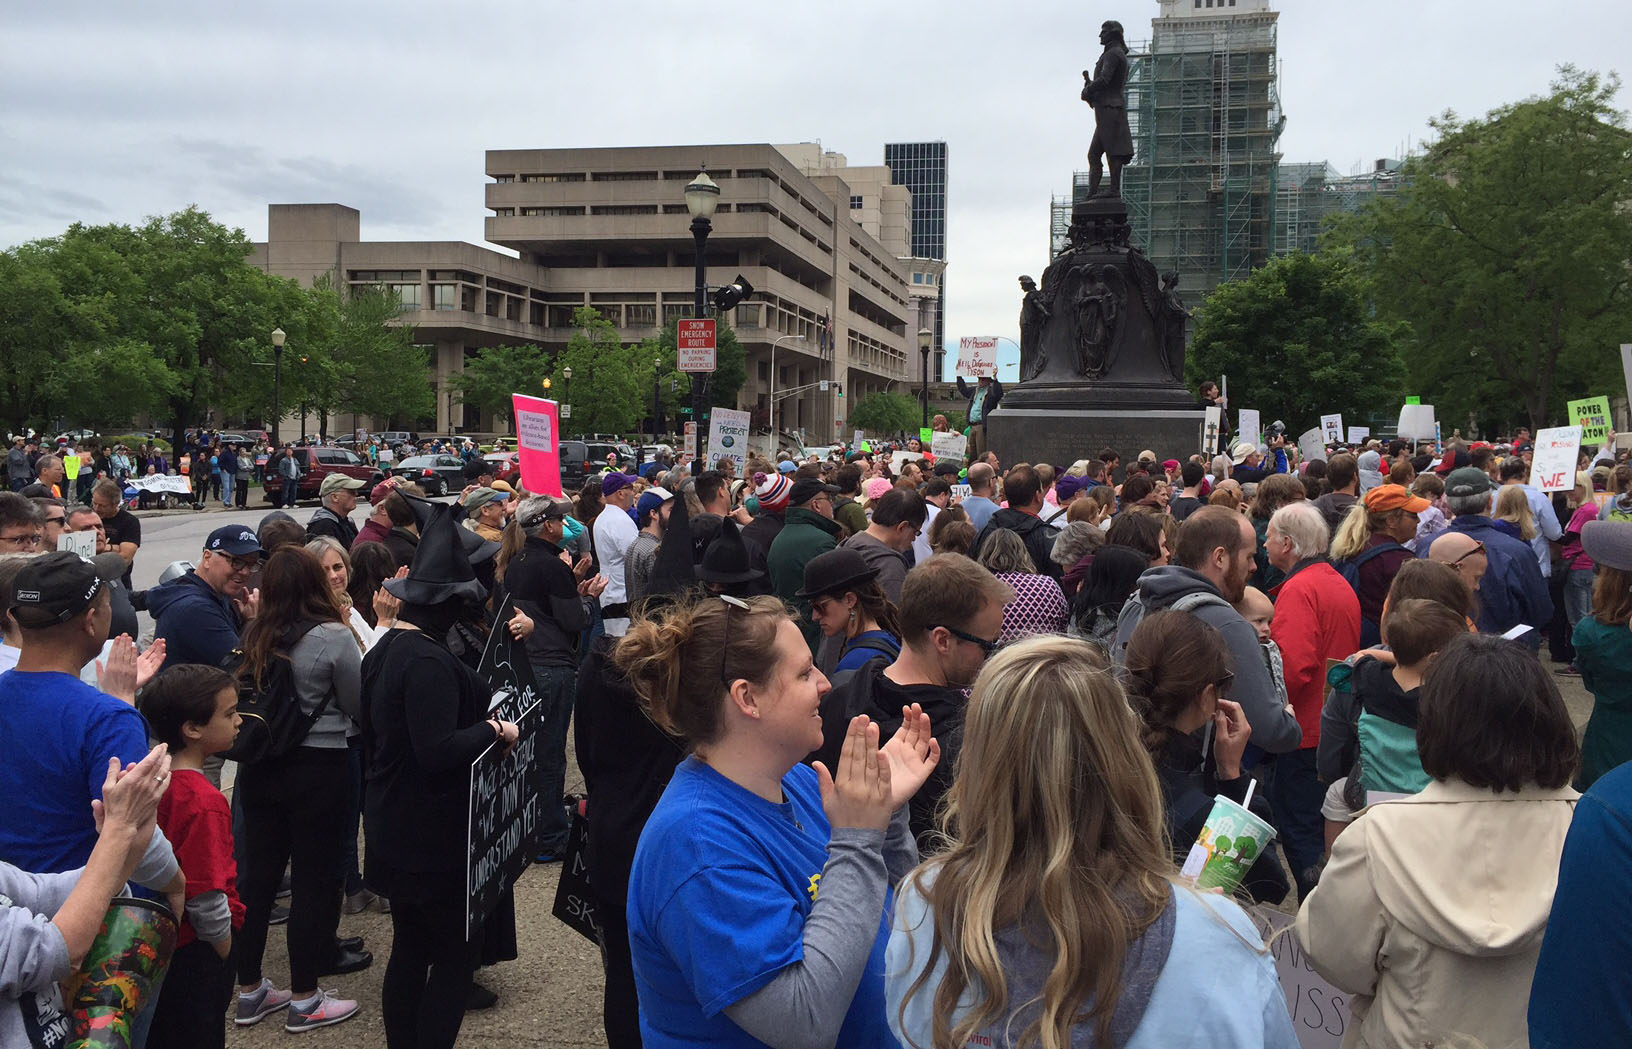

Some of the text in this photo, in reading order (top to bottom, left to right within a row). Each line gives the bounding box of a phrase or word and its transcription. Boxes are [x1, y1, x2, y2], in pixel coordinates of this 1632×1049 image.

[689, 321, 705, 330] SNOW
[680, 330, 713, 338] EMERGENCY
[687, 339, 705, 347] ROUTE
[960, 337, 972, 348] MY
[1576, 404, 1602, 416] POWER
[1580, 415, 1605, 427] OF THE
[719, 425, 748, 436] PROTECT
[1540, 471, 1567, 488] WE
[482, 765, 528, 841] WE DON'T
[470, 792, 539, 897] UNDERSTAND YET
